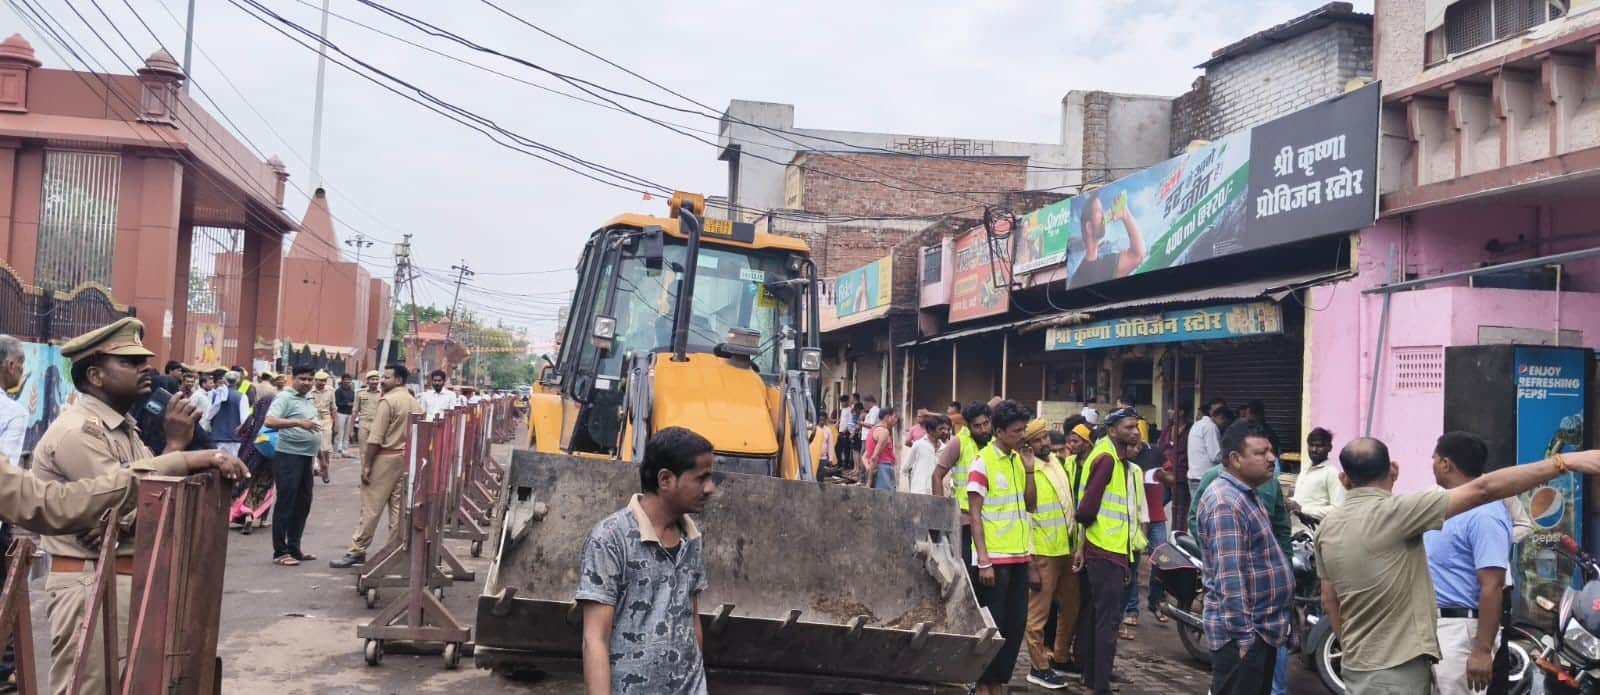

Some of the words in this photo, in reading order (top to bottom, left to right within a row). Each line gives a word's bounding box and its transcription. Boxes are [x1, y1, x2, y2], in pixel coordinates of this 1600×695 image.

[1273, 145, 1294, 177] श्री
[1297, 133, 1346, 176] कृष्णा
[1255, 181, 1321, 218] प्रोविजन
[1325, 166, 1364, 201] स्टोर
[1165, 226, 1183, 255] 400
[1183, 213, 1196, 240] ml
[1073, 325, 1111, 346] कृष्णा
[1115, 317, 1178, 338] प्रोविजन
[1182, 309, 1222, 332] स्टोर
[1518, 376, 1580, 389] REFRESHING
[1529, 365, 1561, 377] ENJOY
[1518, 388, 1547, 400] PEPSI
